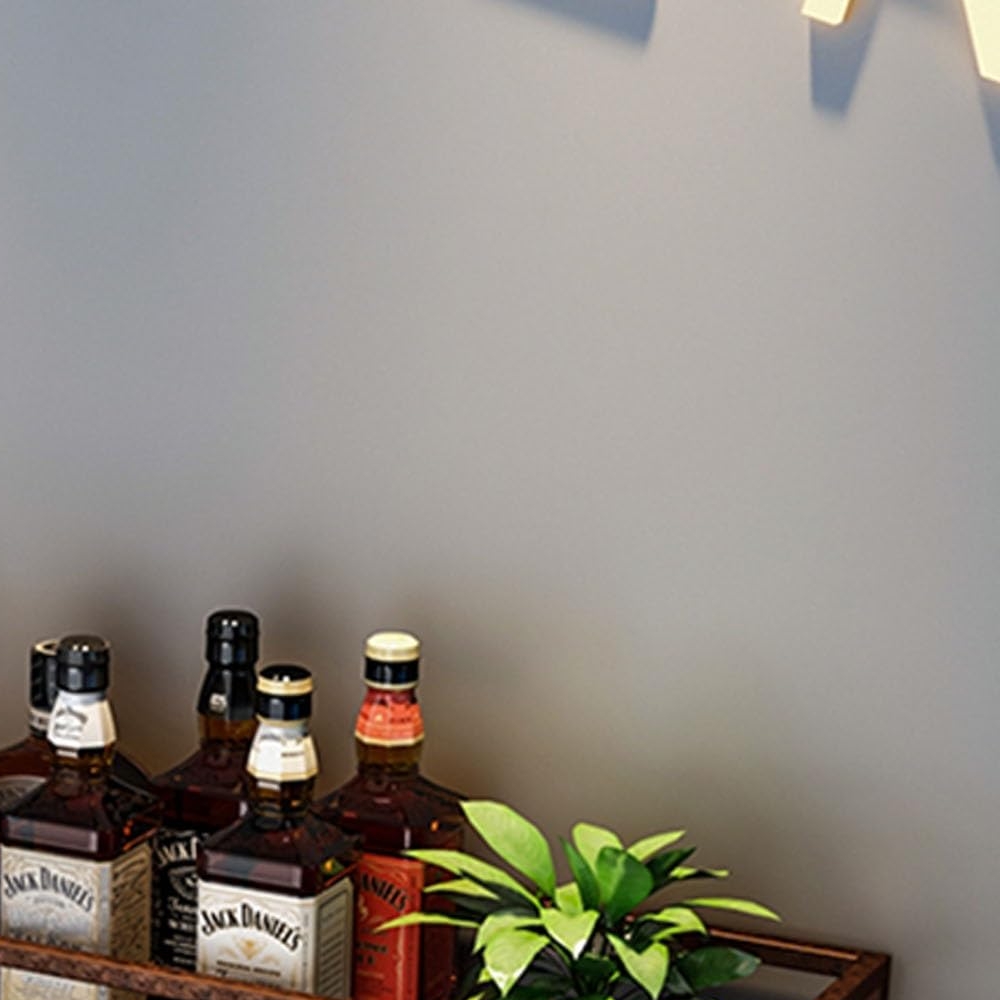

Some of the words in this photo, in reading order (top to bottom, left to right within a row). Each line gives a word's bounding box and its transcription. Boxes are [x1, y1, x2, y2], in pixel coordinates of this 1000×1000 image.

[3, 872, 39, 899] JACK
[361, 872, 407, 912] ANIEL'S
[202, 909, 240, 936] JACK
[241, 903, 302, 952] DANIEL'S
